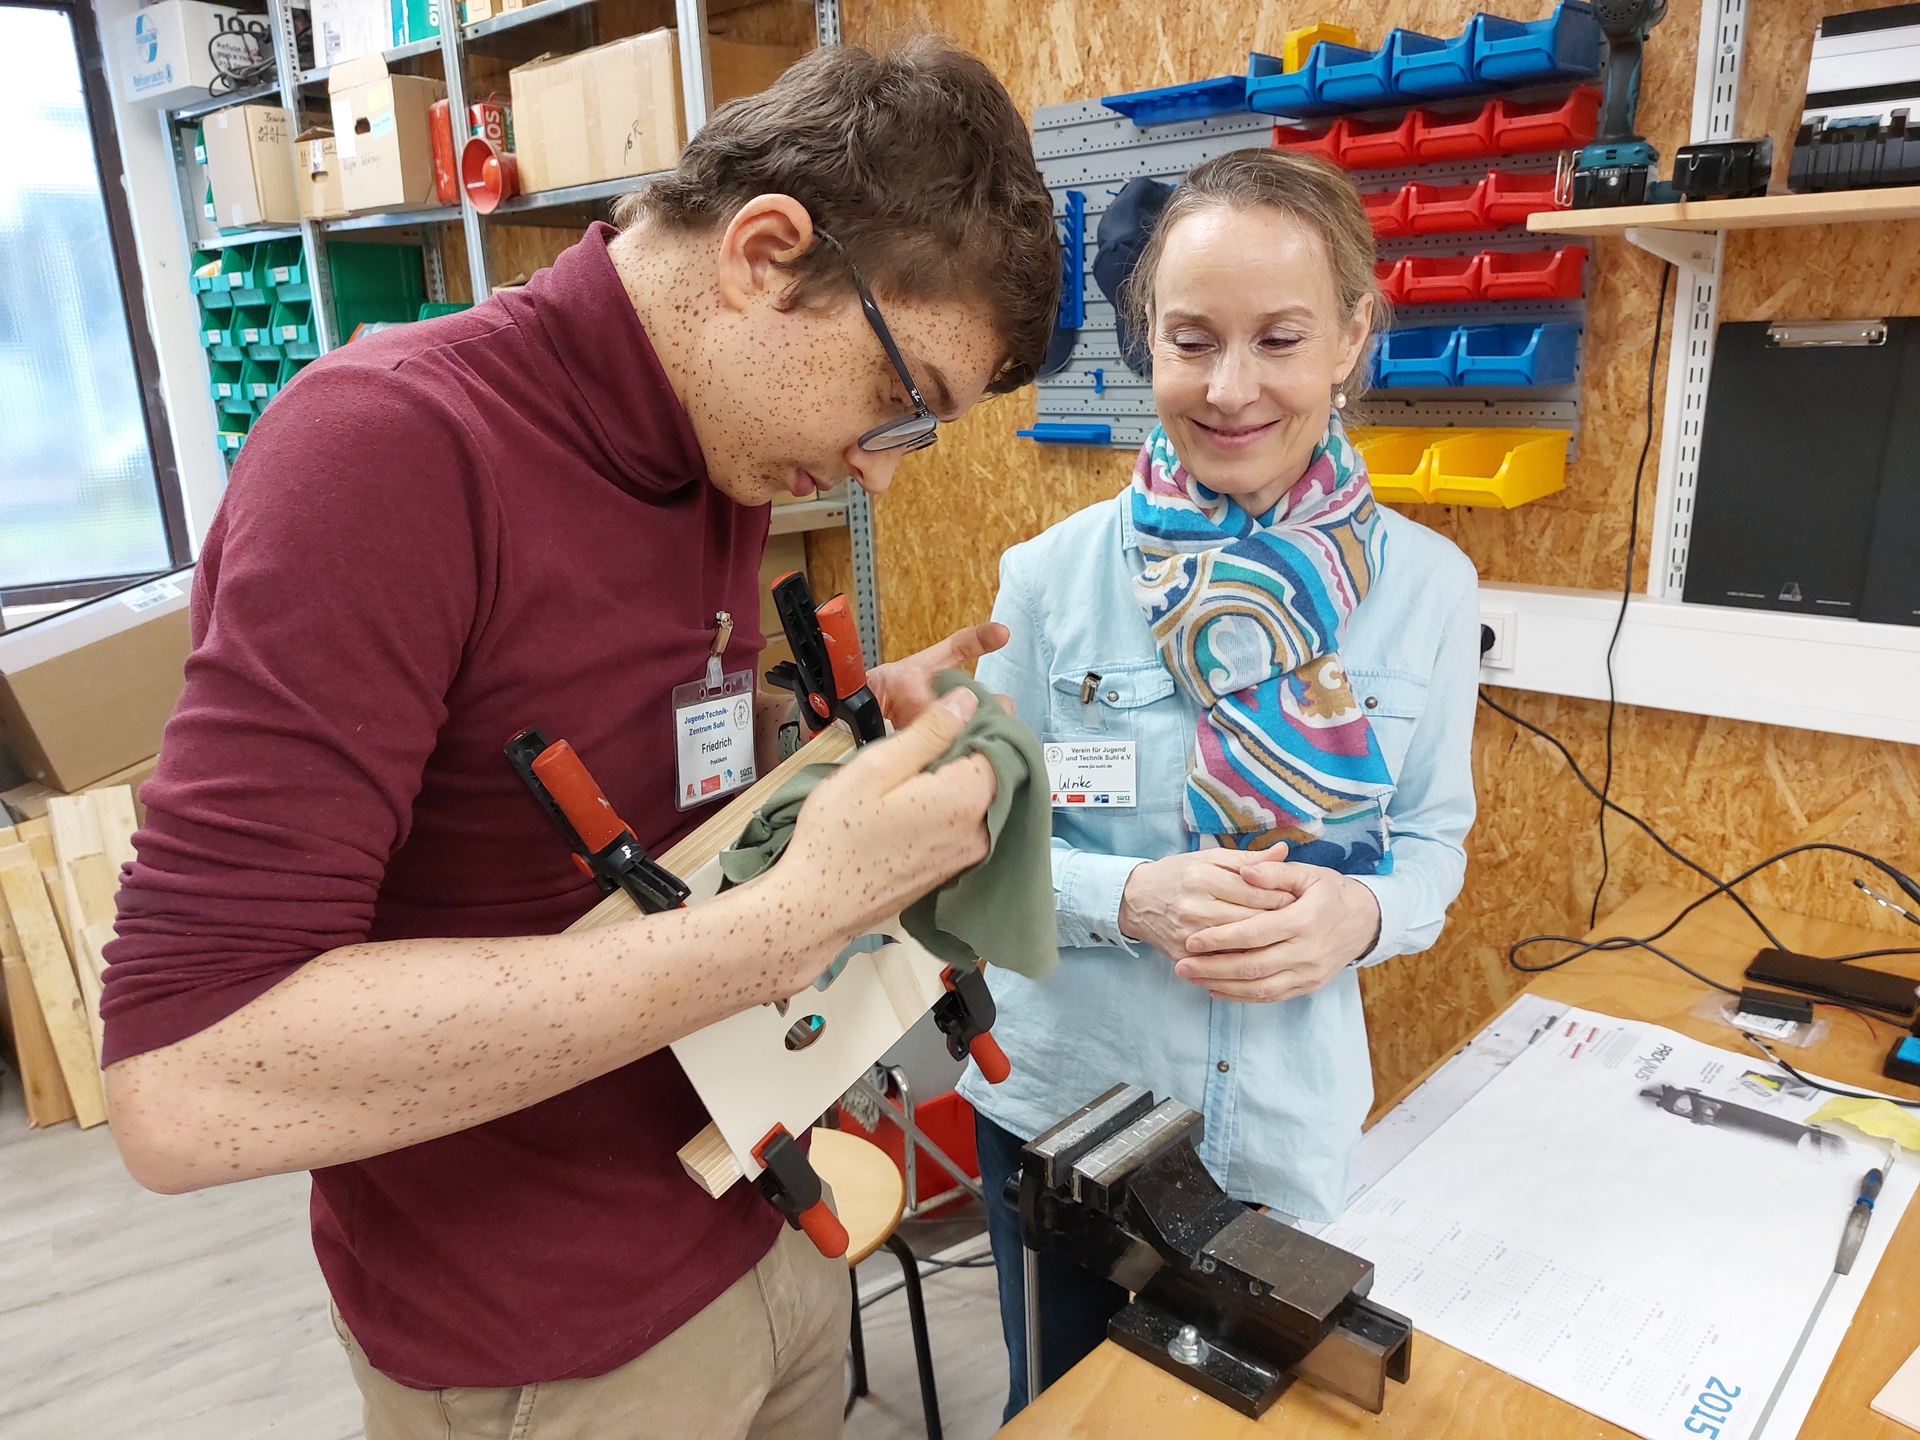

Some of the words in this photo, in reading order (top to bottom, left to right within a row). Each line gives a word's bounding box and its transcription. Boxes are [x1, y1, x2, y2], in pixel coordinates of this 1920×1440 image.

[689, 724, 712, 736] Zentrum
[713, 720, 725, 729] Suhl
[701, 736, 732, 755] Friedrich
[1103, 746, 1126, 754] Jugend
[1059, 773, 1092, 791] Ulrike
[1683, 1375, 1742, 1440] 2015
